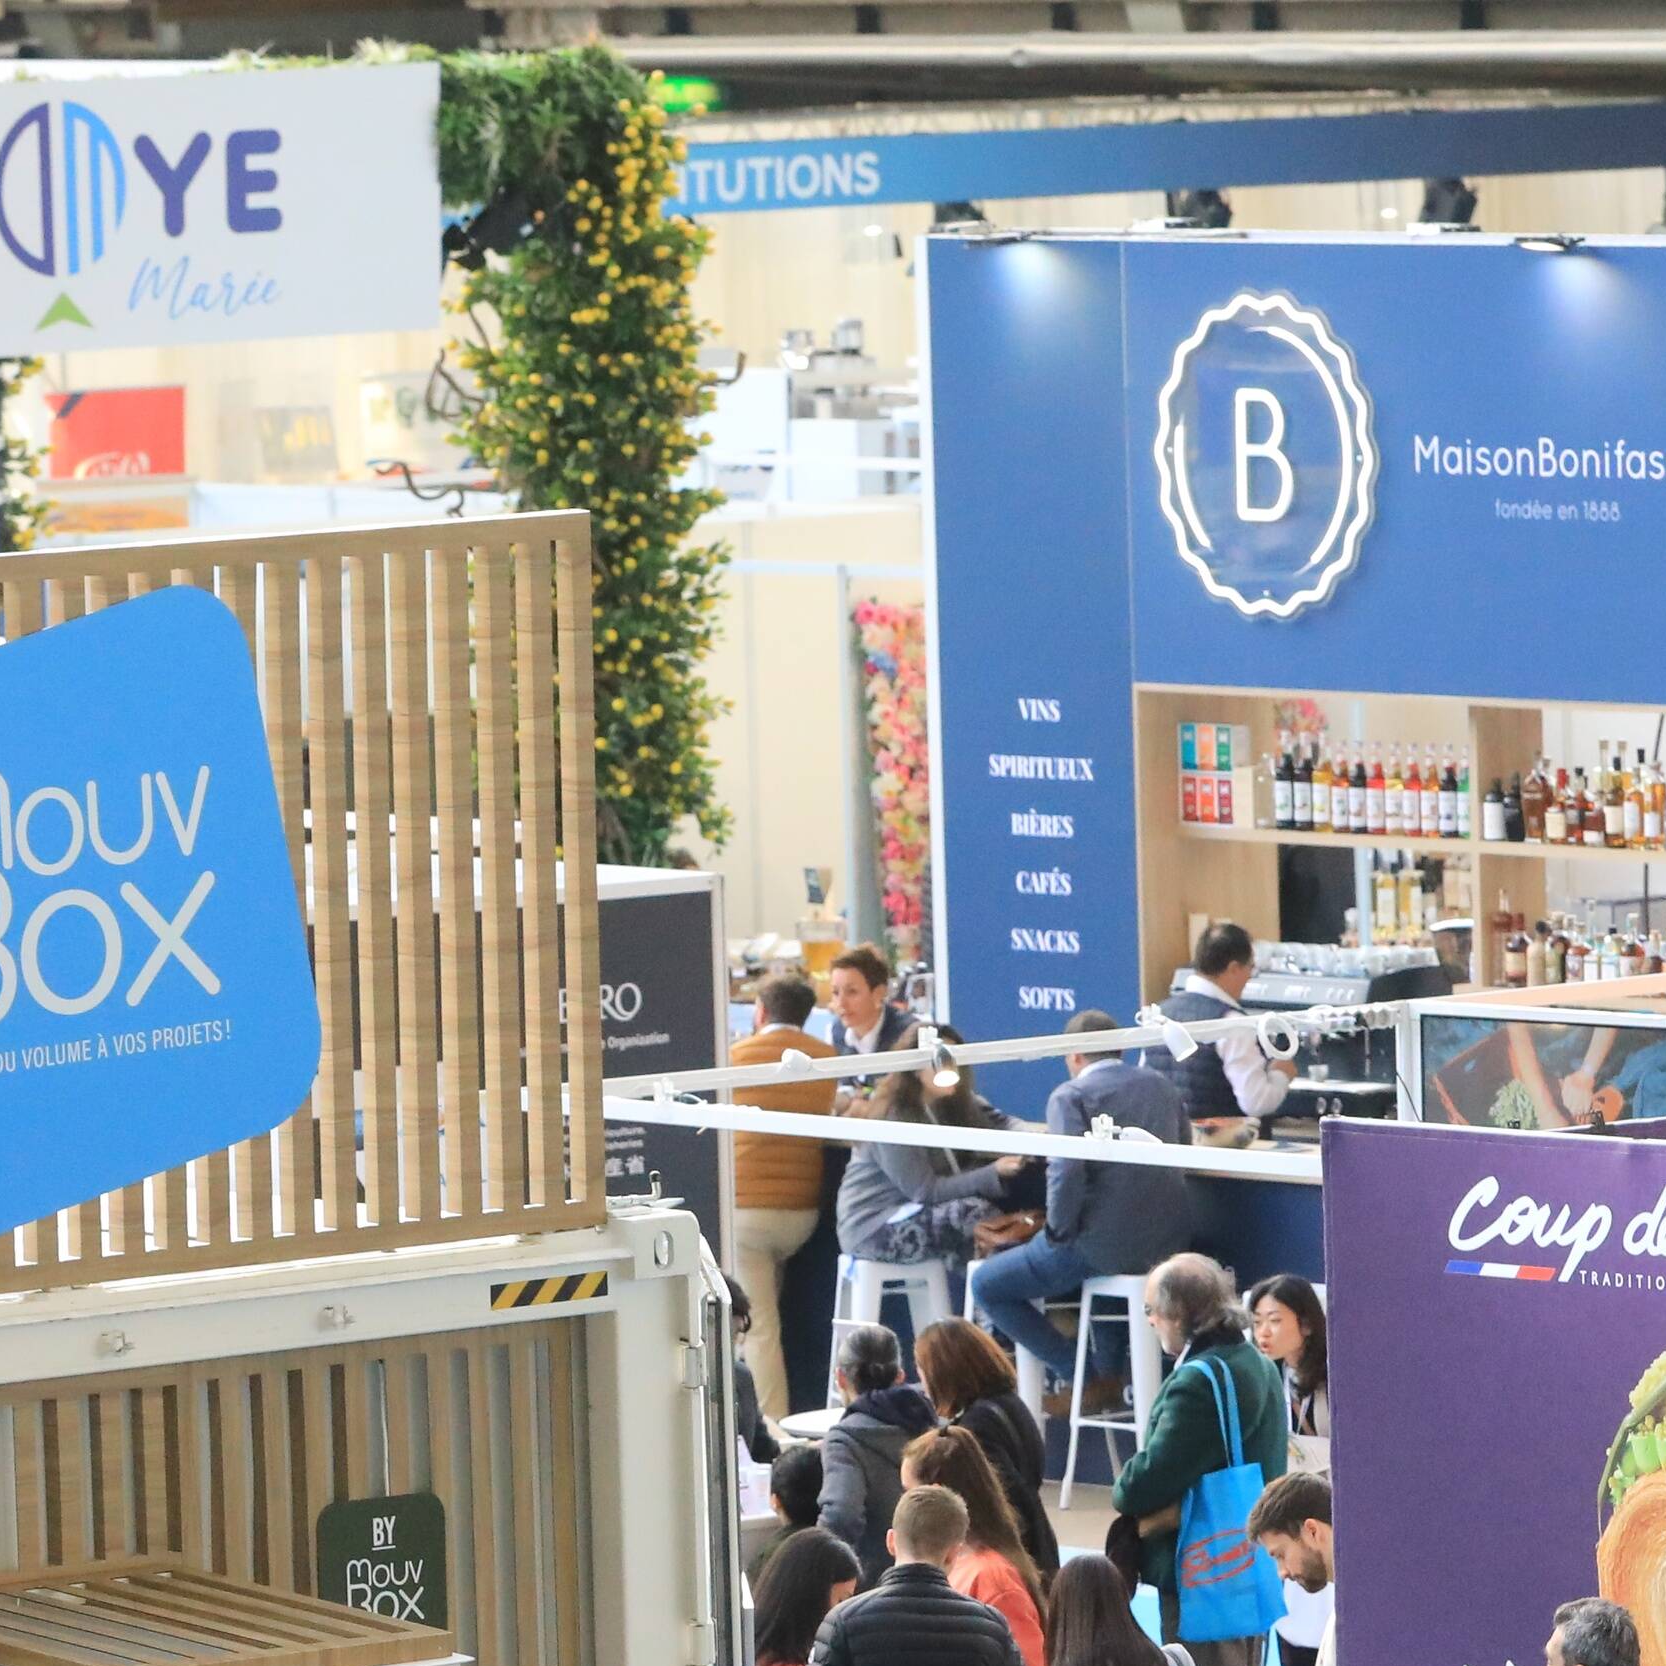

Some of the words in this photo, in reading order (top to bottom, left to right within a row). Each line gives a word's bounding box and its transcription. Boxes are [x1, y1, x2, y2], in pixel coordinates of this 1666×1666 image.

[1235, 387, 1294, 523] B
[1495, 496, 1553, 521] fondée
[1557, 501, 1579, 520] en
[1582, 500, 1621, 522] 1888
[1018, 698, 1061, 723] VINS
[988, 754, 1094, 783] SPIRITUEUX
[1011, 808, 1074, 840] BIÈRES
[1015, 865, 1073, 898] CAFÉS
[1011, 926, 1080, 957] SNACKS
[1019, 984, 1075, 1012] SOFTS
[21, 1041, 91, 1072] VOLUME
[97, 1032, 109, 1060] À
[112, 1034, 147, 1060] VOS
[151, 1021, 225, 1056] PROJETS
[1448, 1176, 1611, 1283] Coup
[371, 1515, 395, 1549] BY
